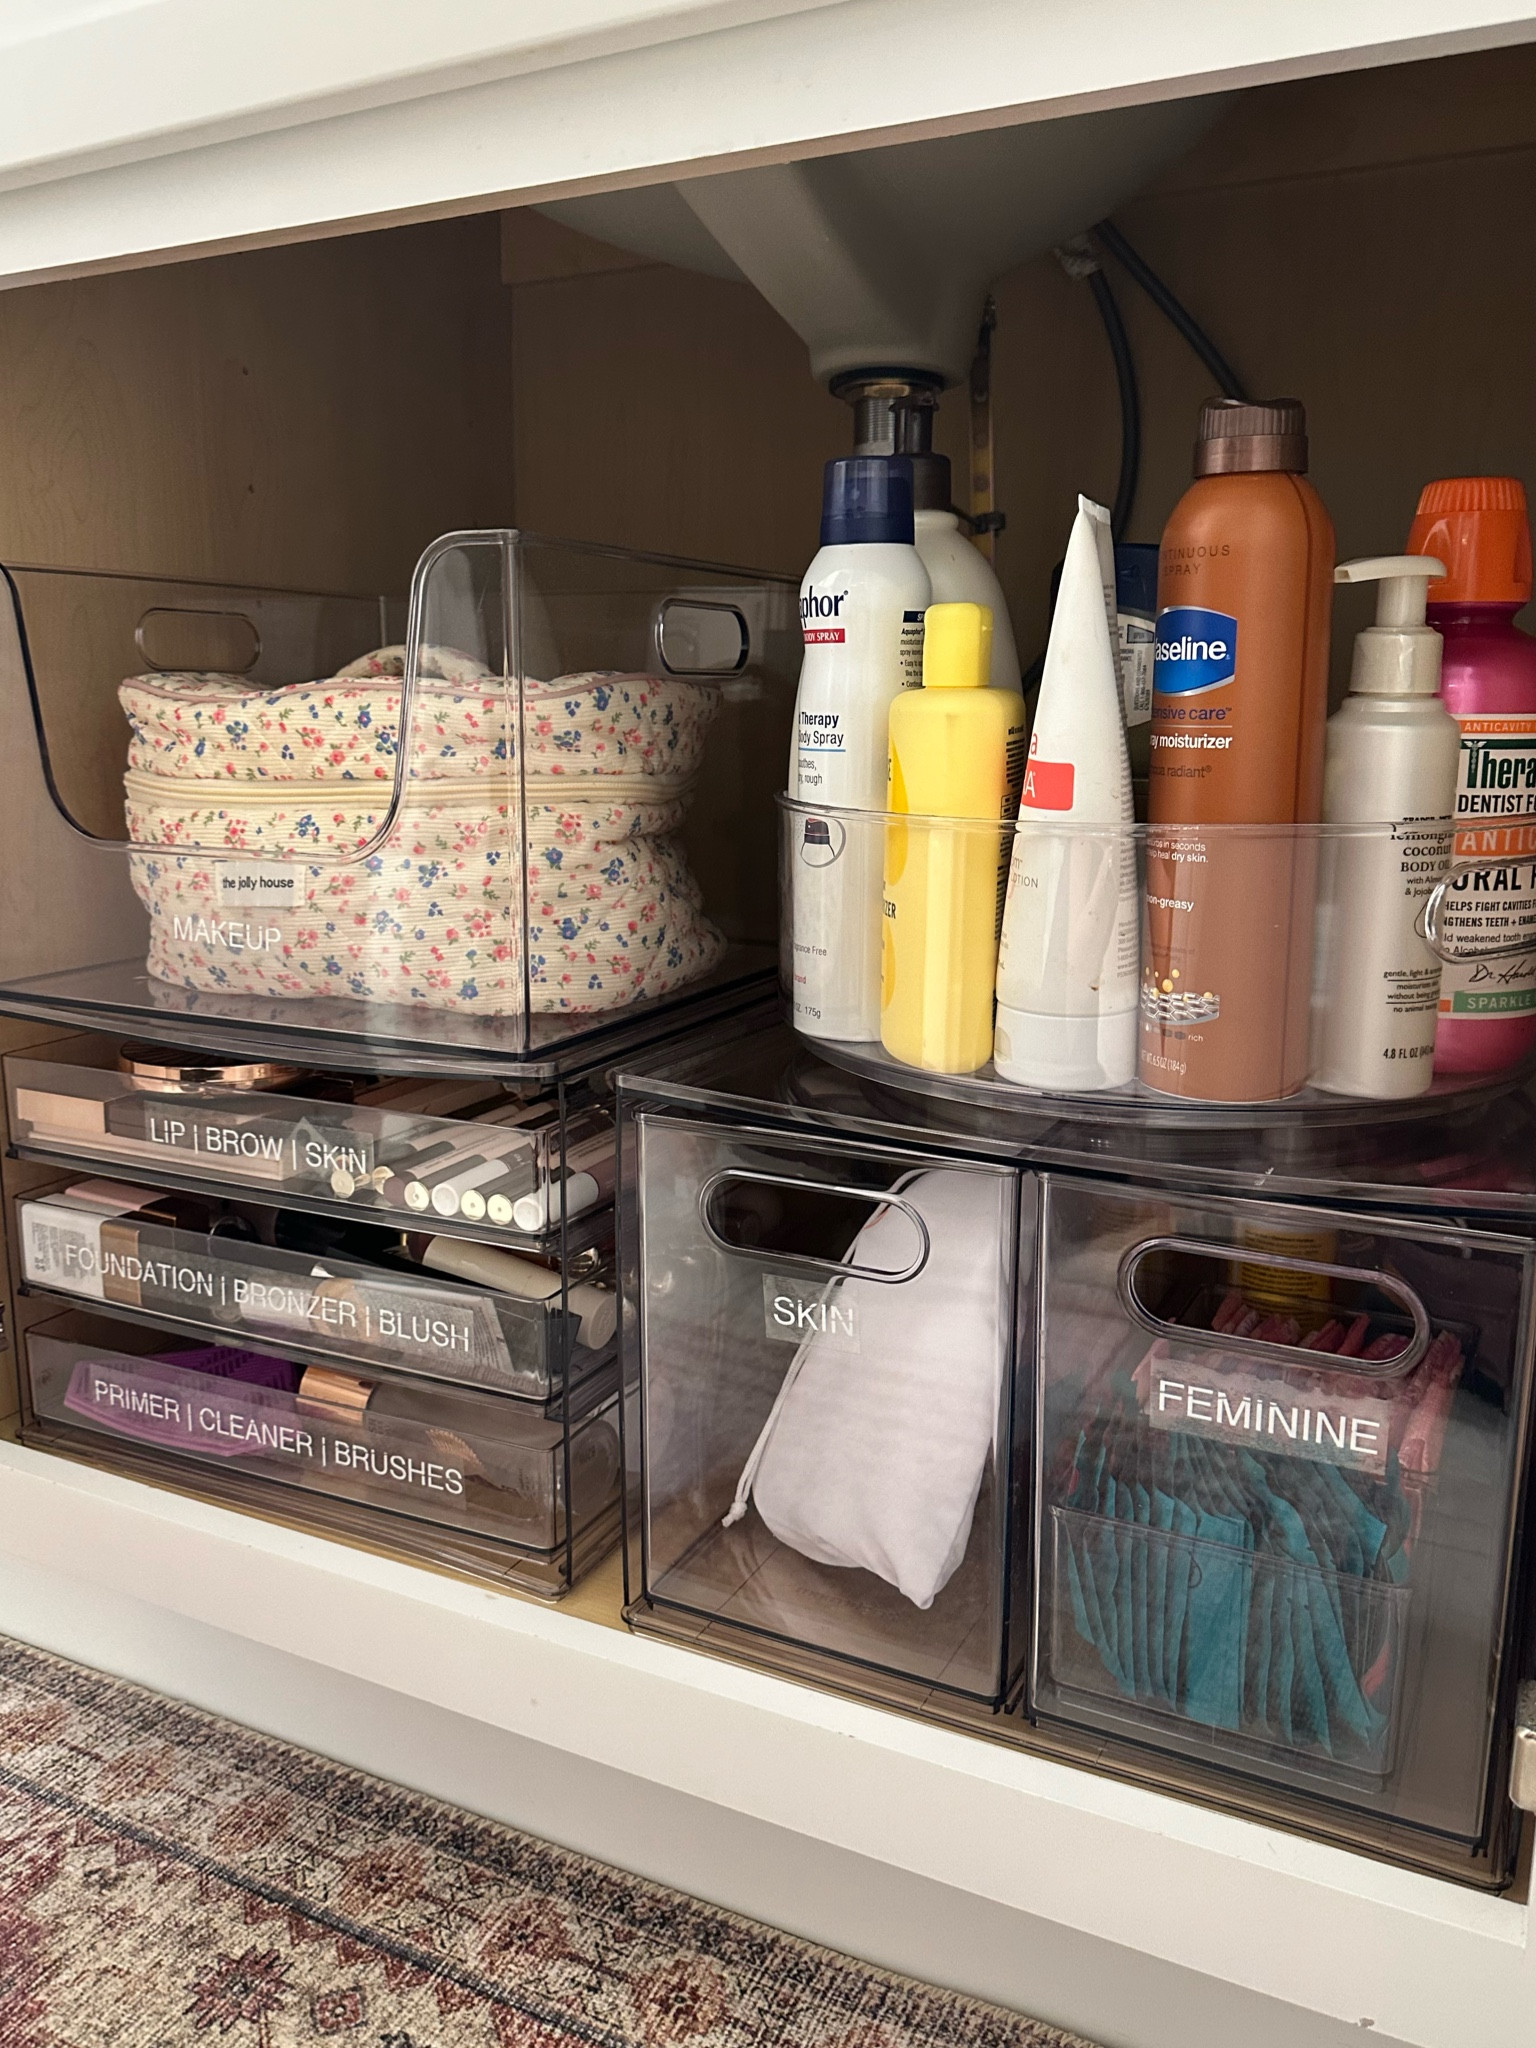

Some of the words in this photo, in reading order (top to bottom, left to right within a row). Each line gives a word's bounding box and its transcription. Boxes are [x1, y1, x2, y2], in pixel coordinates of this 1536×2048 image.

[800, 585, 844, 629] phor
[816, 632, 840, 642] SPRAY
[1155, 636, 1227, 661] aseline
[802, 712, 839, 728] Therapy
[1189, 707, 1226, 721] care
[1464, 722, 1531, 732] ANTICAVITY
[813, 731, 844, 747] Spray
[1159, 733, 1233, 749] moisturizer
[1458, 794, 1523, 813] DENTIST
[1171, 842, 1206, 852] seconds
[1171, 852, 1185, 863] dry
[1187, 853, 1208, 863] skin.
[1401, 862, 1436, 872] BODY
[222, 877, 236, 889] the
[238, 876, 258, 891] jolly
[260, 876, 294, 888] house
[1475, 901, 1501, 912] FIGHT
[1503, 900, 1531, 911] CAVITIES
[1485, 917, 1510, 927] TEETH
[173, 915, 282, 952] MAKEUP
[1456, 934, 1501, 943] weakened
[1504, 933, 1521, 942] tooth
[812, 946, 827, 956] Free
[1467, 994, 1531, 1009] SPARKLE
[805, 1006, 821, 1019] 175g
[1188, 1034, 1204, 1042] rich
[1383, 1048, 1396, 1059] 4.8
[1399, 1048, 1407, 1059] FL
[1409, 1047, 1418, 1058] OZ
[150, 1118, 186, 1145] LIP
[206, 1126, 283, 1161] BROW
[305, 1142, 367, 1174] SKIN
[65, 1245, 213, 1297] FOUNDATION
[233, 1278, 356, 1328] BRONZER
[379, 1308, 469, 1352] BLUSH
[773, 1296, 854, 1337] SKIN
[1158, 1379, 1381, 1456] FEMININE
[94, 1380, 180, 1422] PRIMER
[200, 1407, 313, 1457] CLEANER
[335, 1440, 463, 1495] BRUSHES
